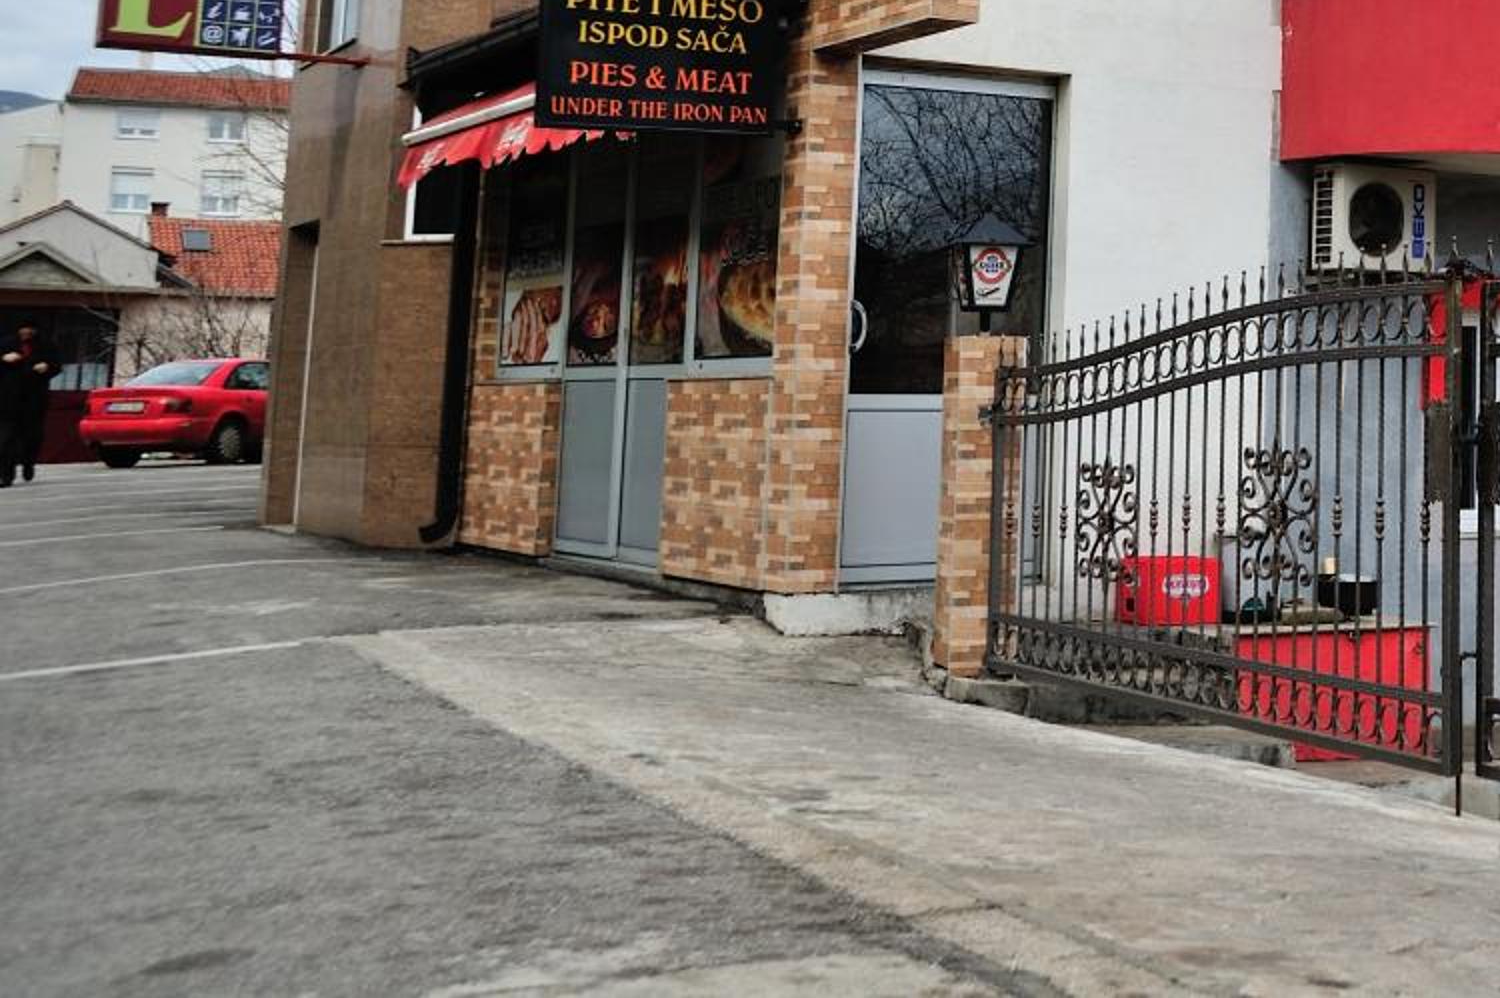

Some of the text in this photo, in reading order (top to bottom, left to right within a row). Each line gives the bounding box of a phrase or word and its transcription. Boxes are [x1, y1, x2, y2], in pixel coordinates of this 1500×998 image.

[578, 20, 747, 54] ISPOD SAČA
[570, 61, 753, 94] PIES & MEAT
[551, 95, 767, 123] UNDER THE IRON PAN
